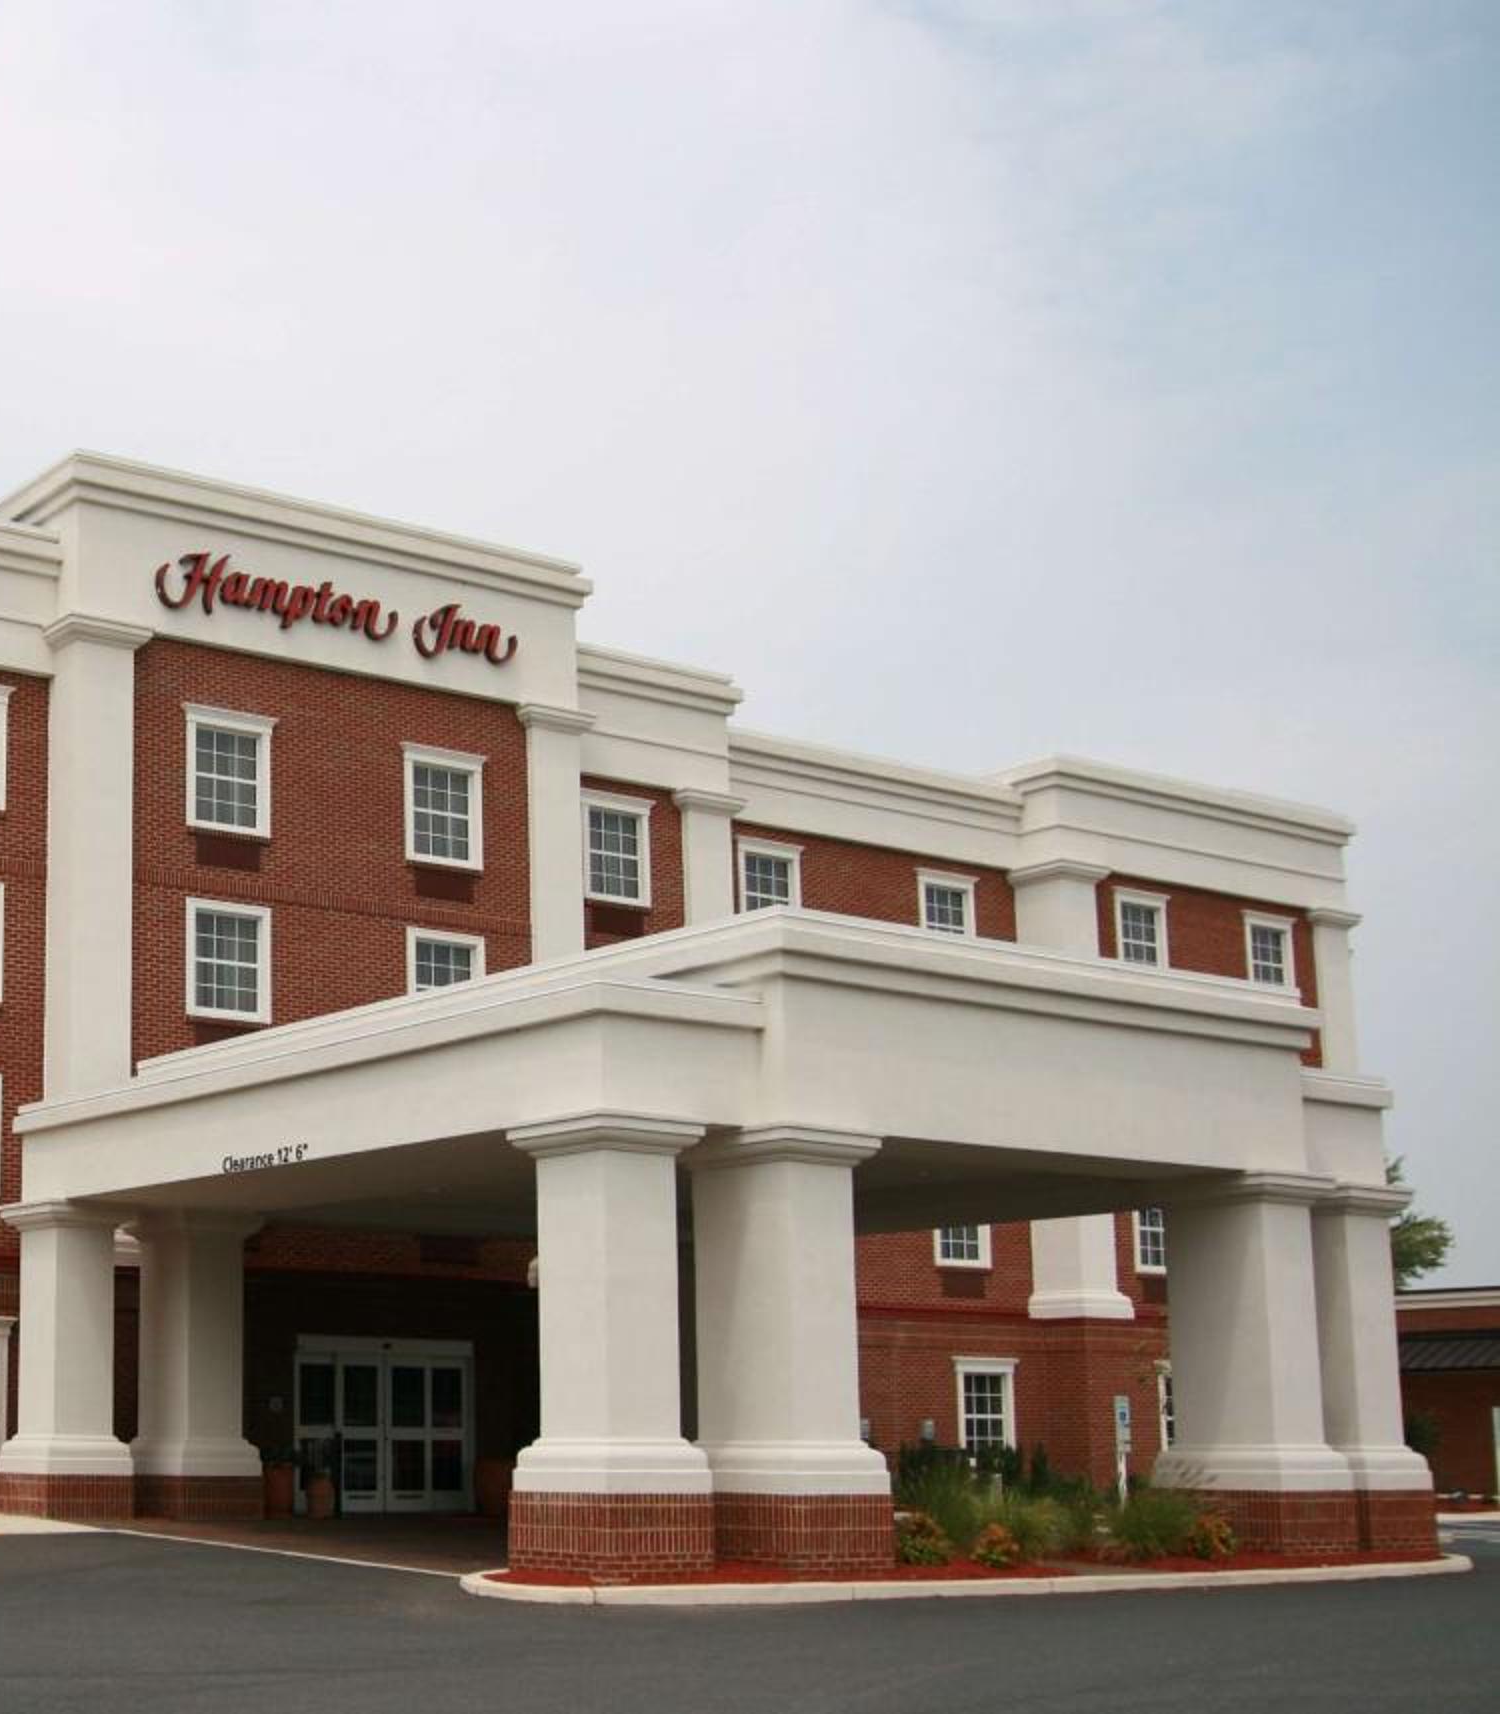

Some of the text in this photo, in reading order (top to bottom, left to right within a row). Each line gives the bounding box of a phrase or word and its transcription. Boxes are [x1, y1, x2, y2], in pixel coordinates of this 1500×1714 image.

[154, 551, 518, 665] Hampton Inn
[222, 1152, 274, 1173] Clearance
